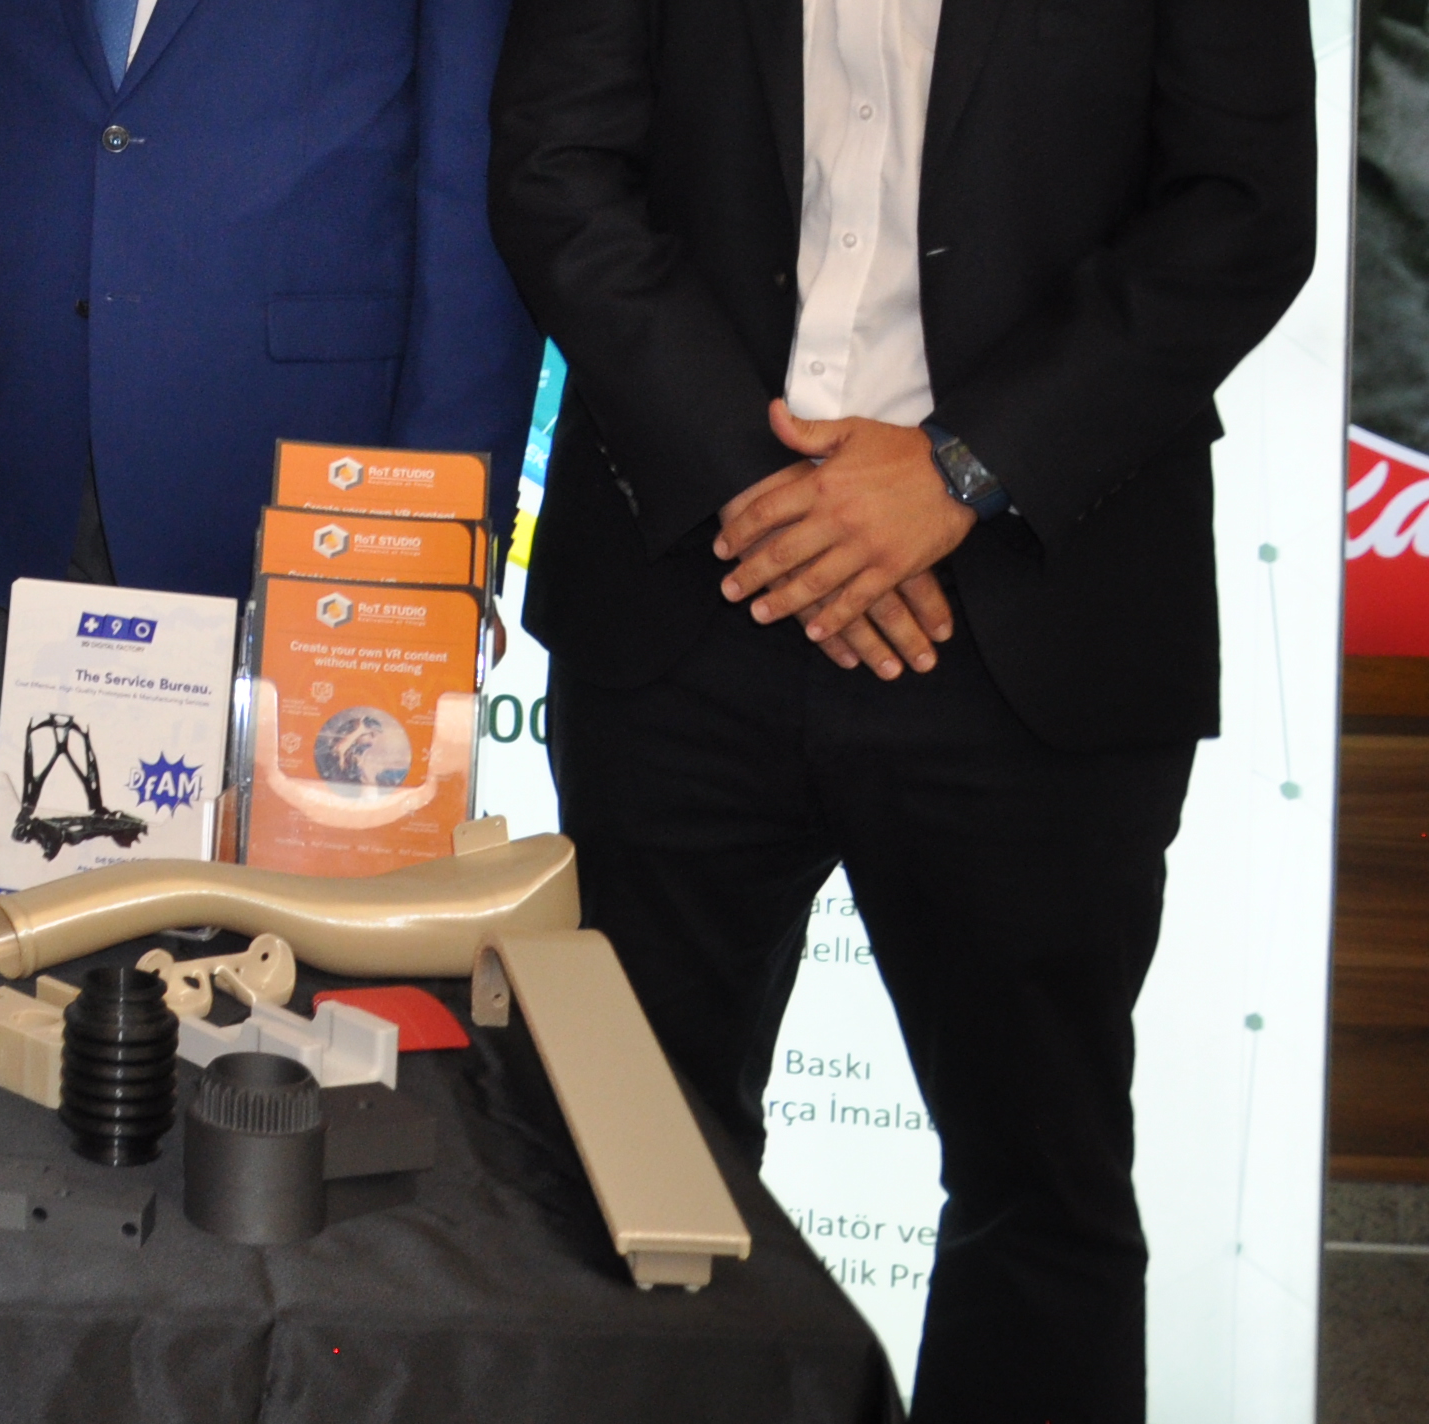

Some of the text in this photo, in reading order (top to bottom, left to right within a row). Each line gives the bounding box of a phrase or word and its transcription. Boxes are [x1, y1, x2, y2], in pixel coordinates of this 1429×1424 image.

[392, 467, 436, 480] STUDIO
[378, 535, 422, 548] STUDIO
[383, 604, 428, 617] STUDIO
[290, 640, 448, 663] Create your own VR content
[314, 656, 358, 670] without
[359, 660, 381, 674] any
[75, 669, 213, 695] The Service Bureau.
[128, 767, 203, 802] DfAM
[785, 1048, 871, 1080] Baskı
